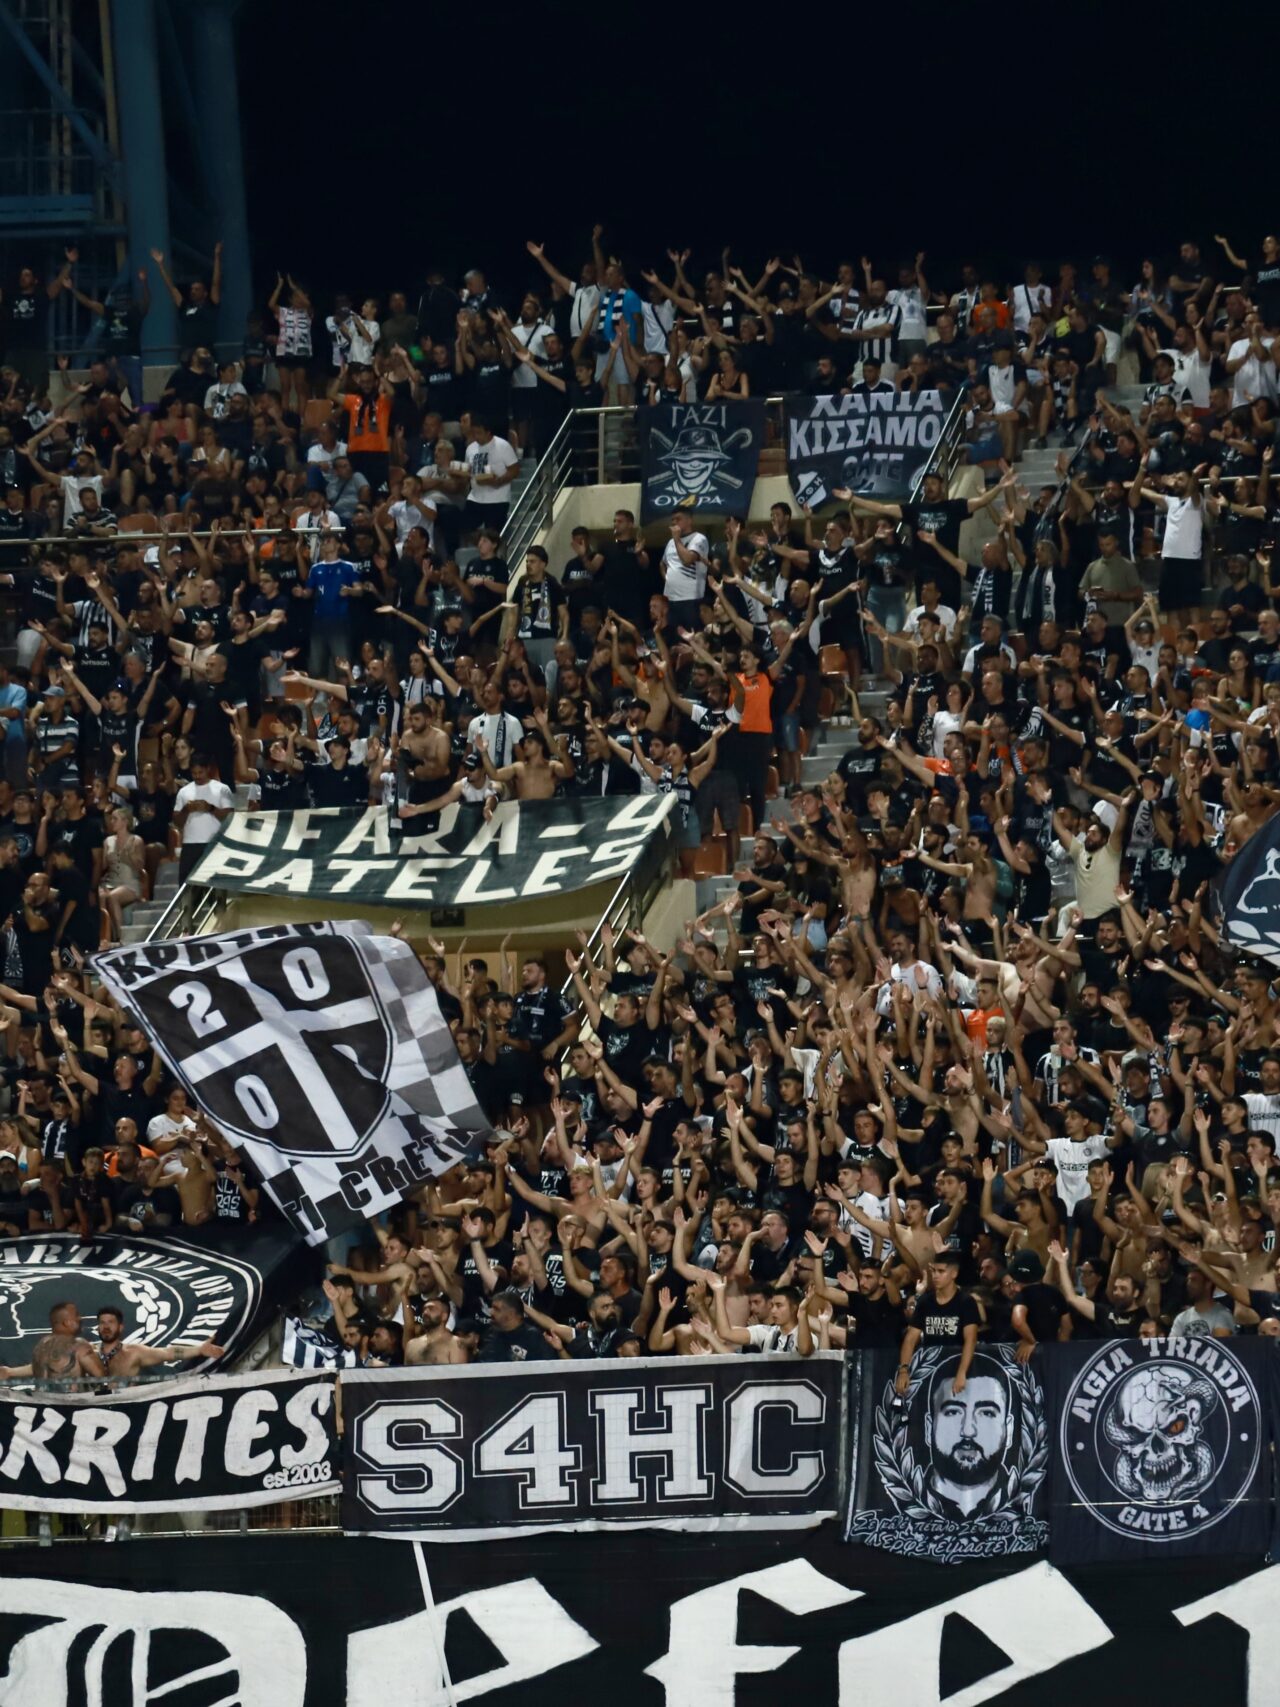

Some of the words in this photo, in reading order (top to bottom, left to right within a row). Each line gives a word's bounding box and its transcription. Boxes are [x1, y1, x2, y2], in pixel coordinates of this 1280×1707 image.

[789, 413, 951, 460] ΚΙΣΣΑΜΟ
[187, 842, 644, 905] PATELES
[108, 1248, 210, 1281] FULL
[189, 1274, 235, 1298] OF
[1072, 1347, 1134, 1424] AGIA
[1141, 1336, 1251, 1413] TRIADA
[0, 1382, 336, 1498] KRITES
[356, 1379, 827, 1514] S4HC
[1117, 1505, 1189, 1532] GATE
[1191, 1503, 1210, 1519] 4
